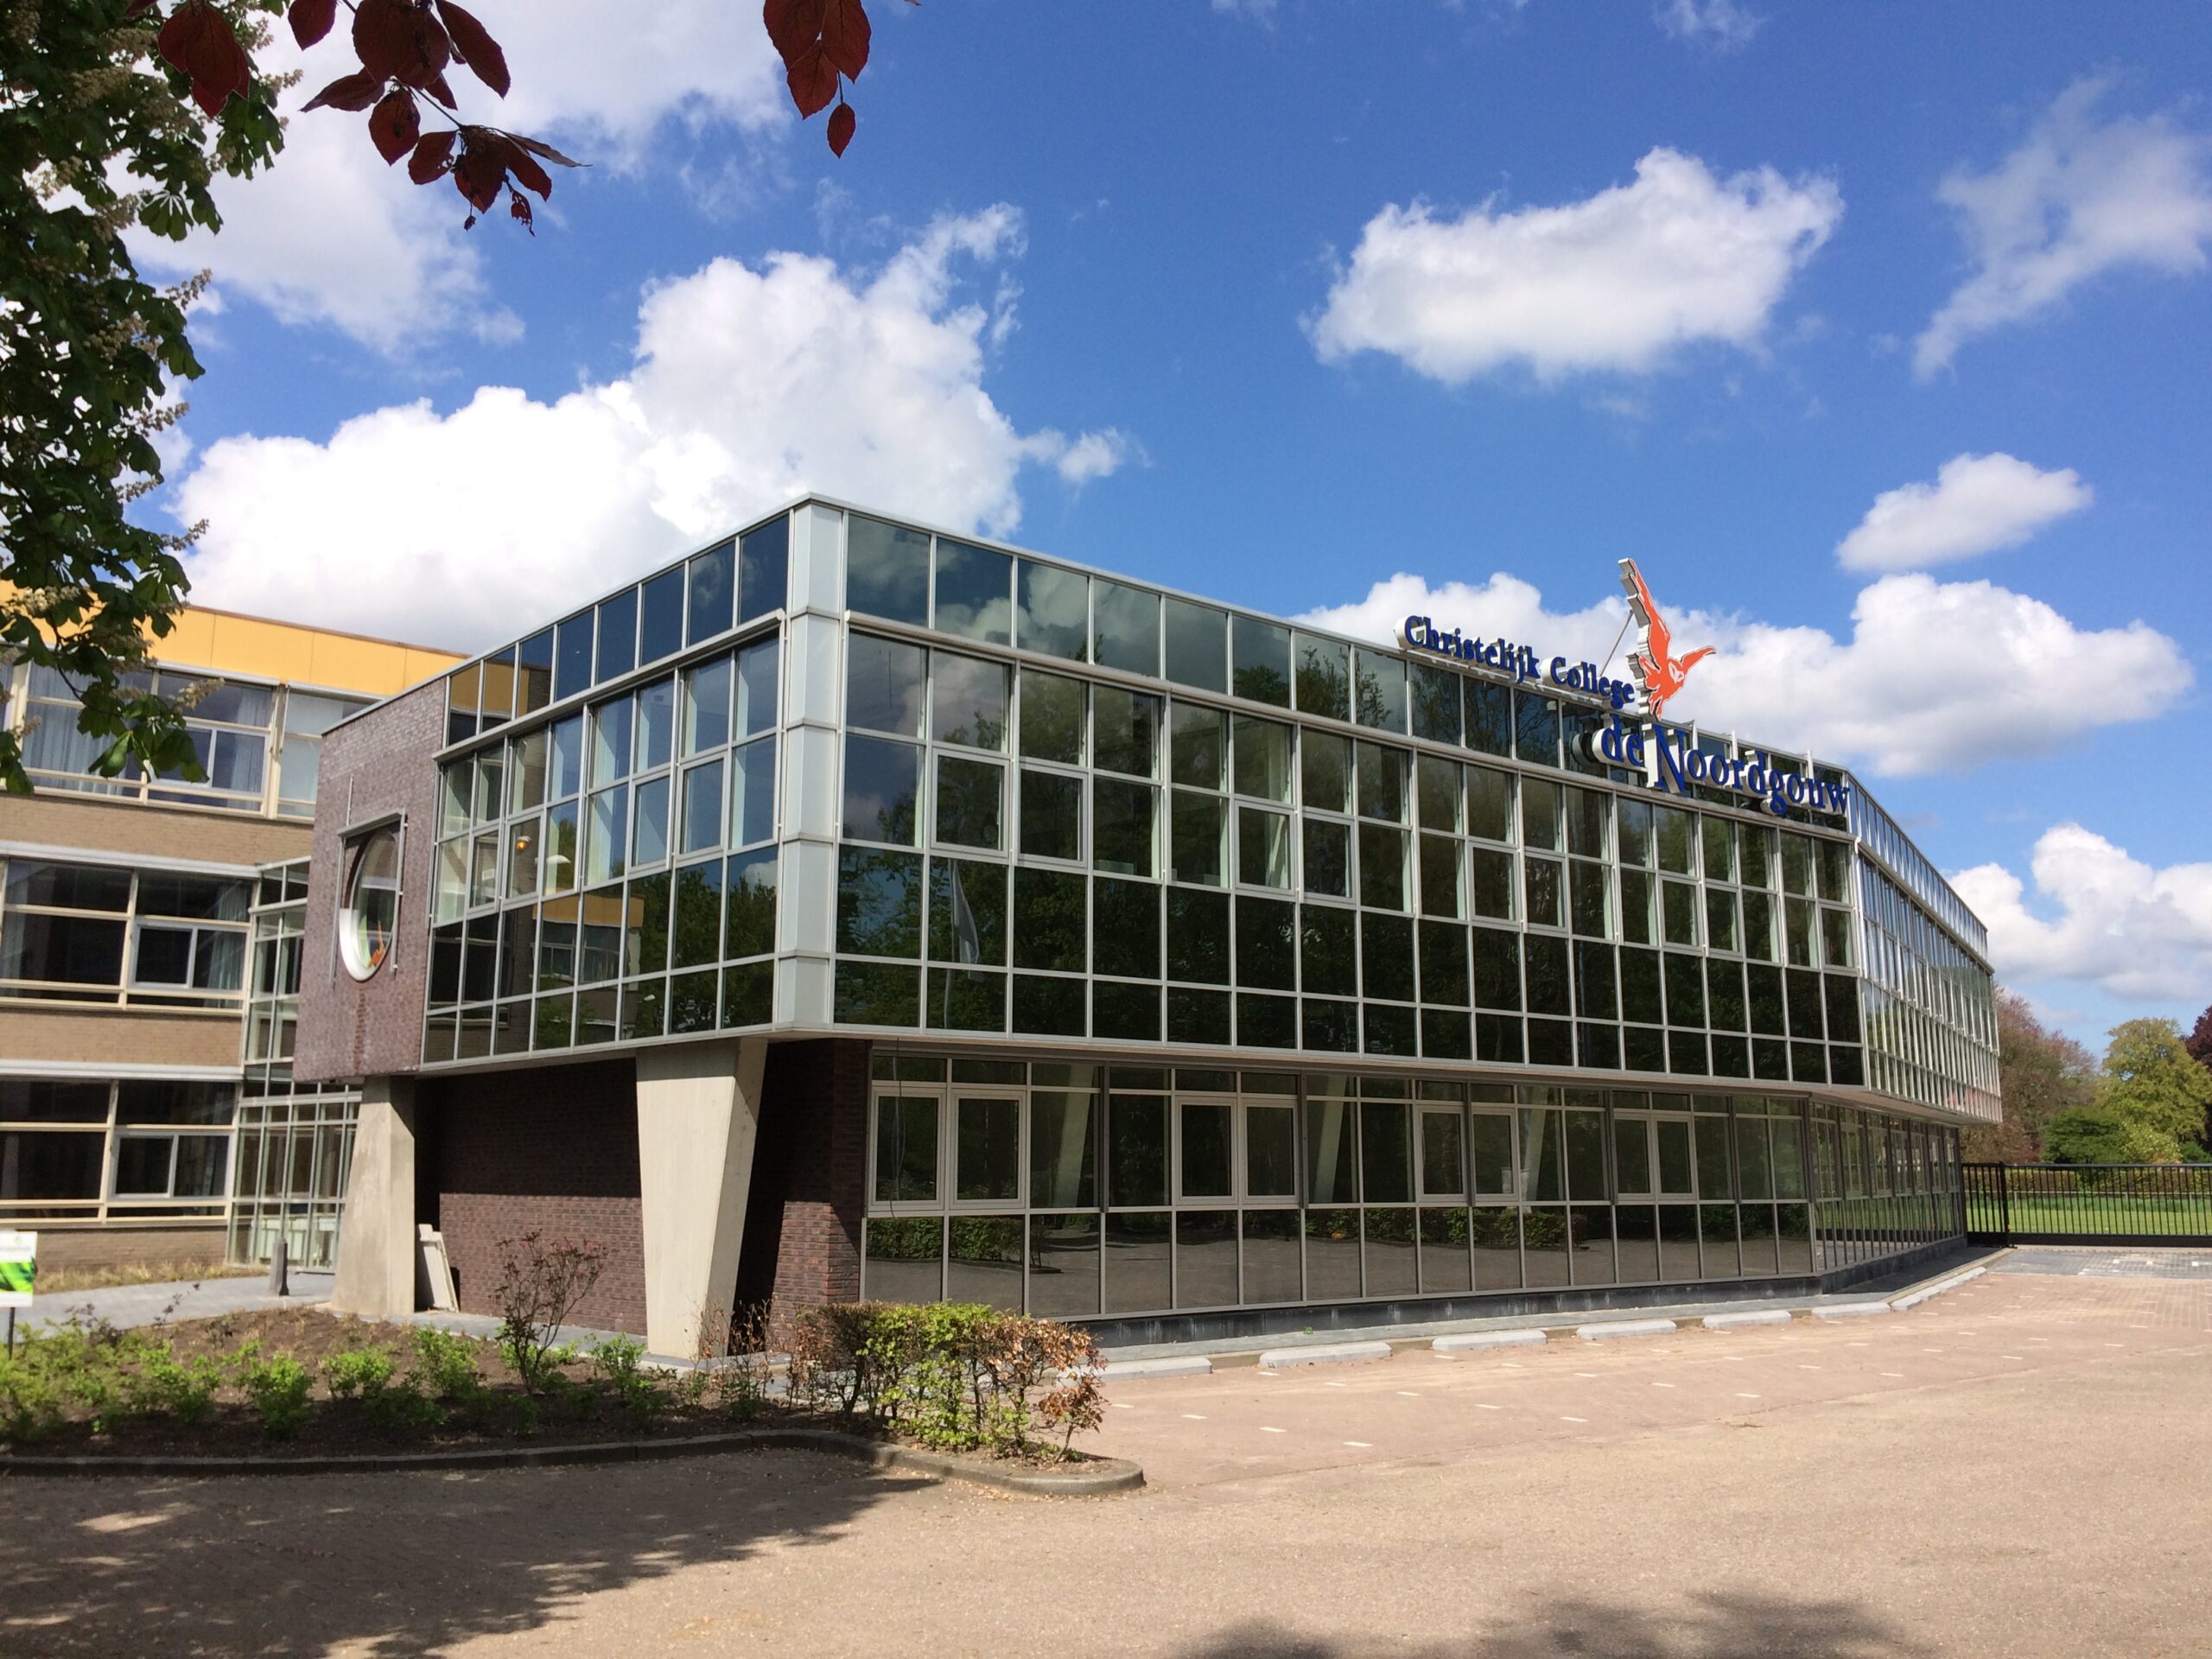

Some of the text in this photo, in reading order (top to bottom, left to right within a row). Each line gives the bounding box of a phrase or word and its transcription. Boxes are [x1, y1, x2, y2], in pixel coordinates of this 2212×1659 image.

[1403, 614, 1636, 709] Christelijk College
[1600, 713, 1851, 816] de Noordgouw
